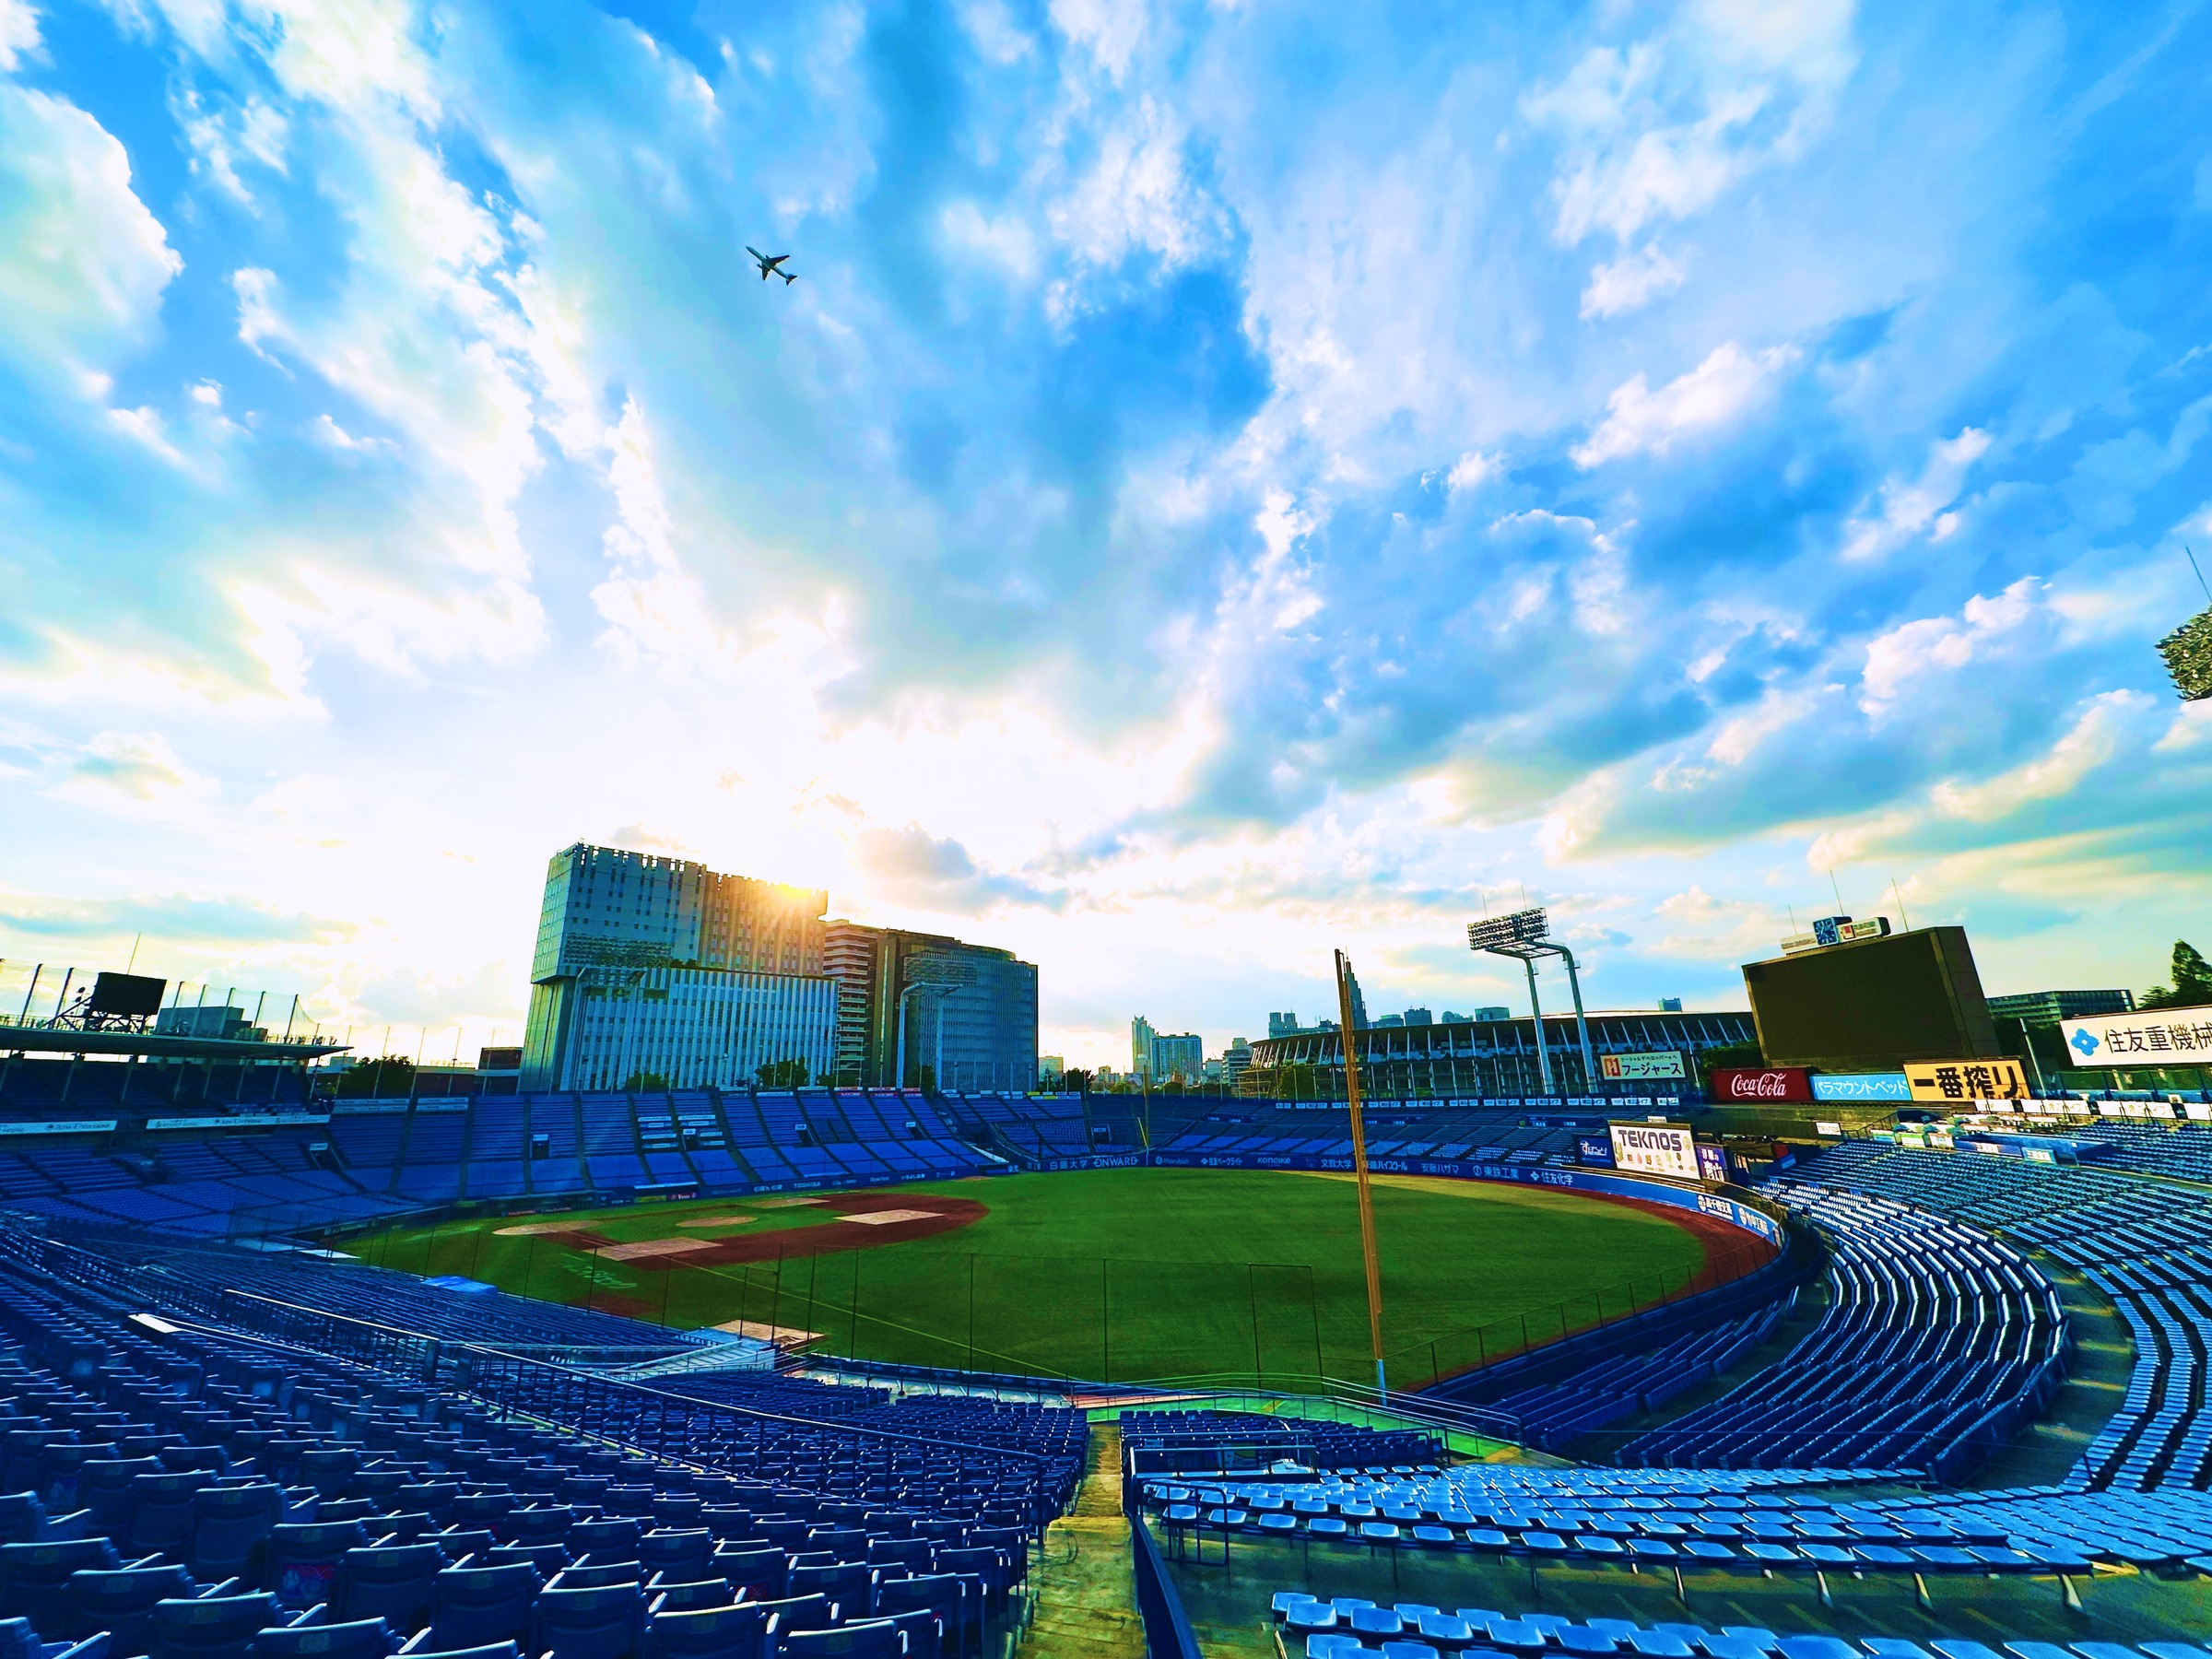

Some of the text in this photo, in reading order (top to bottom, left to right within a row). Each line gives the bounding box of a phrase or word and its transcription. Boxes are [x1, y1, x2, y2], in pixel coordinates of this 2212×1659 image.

[2104, 1021, 2212, 1054] 住友重機械
[1621, 1062, 1682, 1077] フージャース
[1731, 1073, 1787, 1097] Coca-Cola
[1814, 1079, 1908, 1096] パラマウントベッド
[1913, 1065, 2020, 1099] 一番搾り
[1618, 1129, 1682, 1151] TEKNOS
[1093, 1157, 1139, 1168] ONWARD
[794, 1181, 821, 1189] TOSHIBA
[1540, 1171, 1573, 1186] 住友化学
